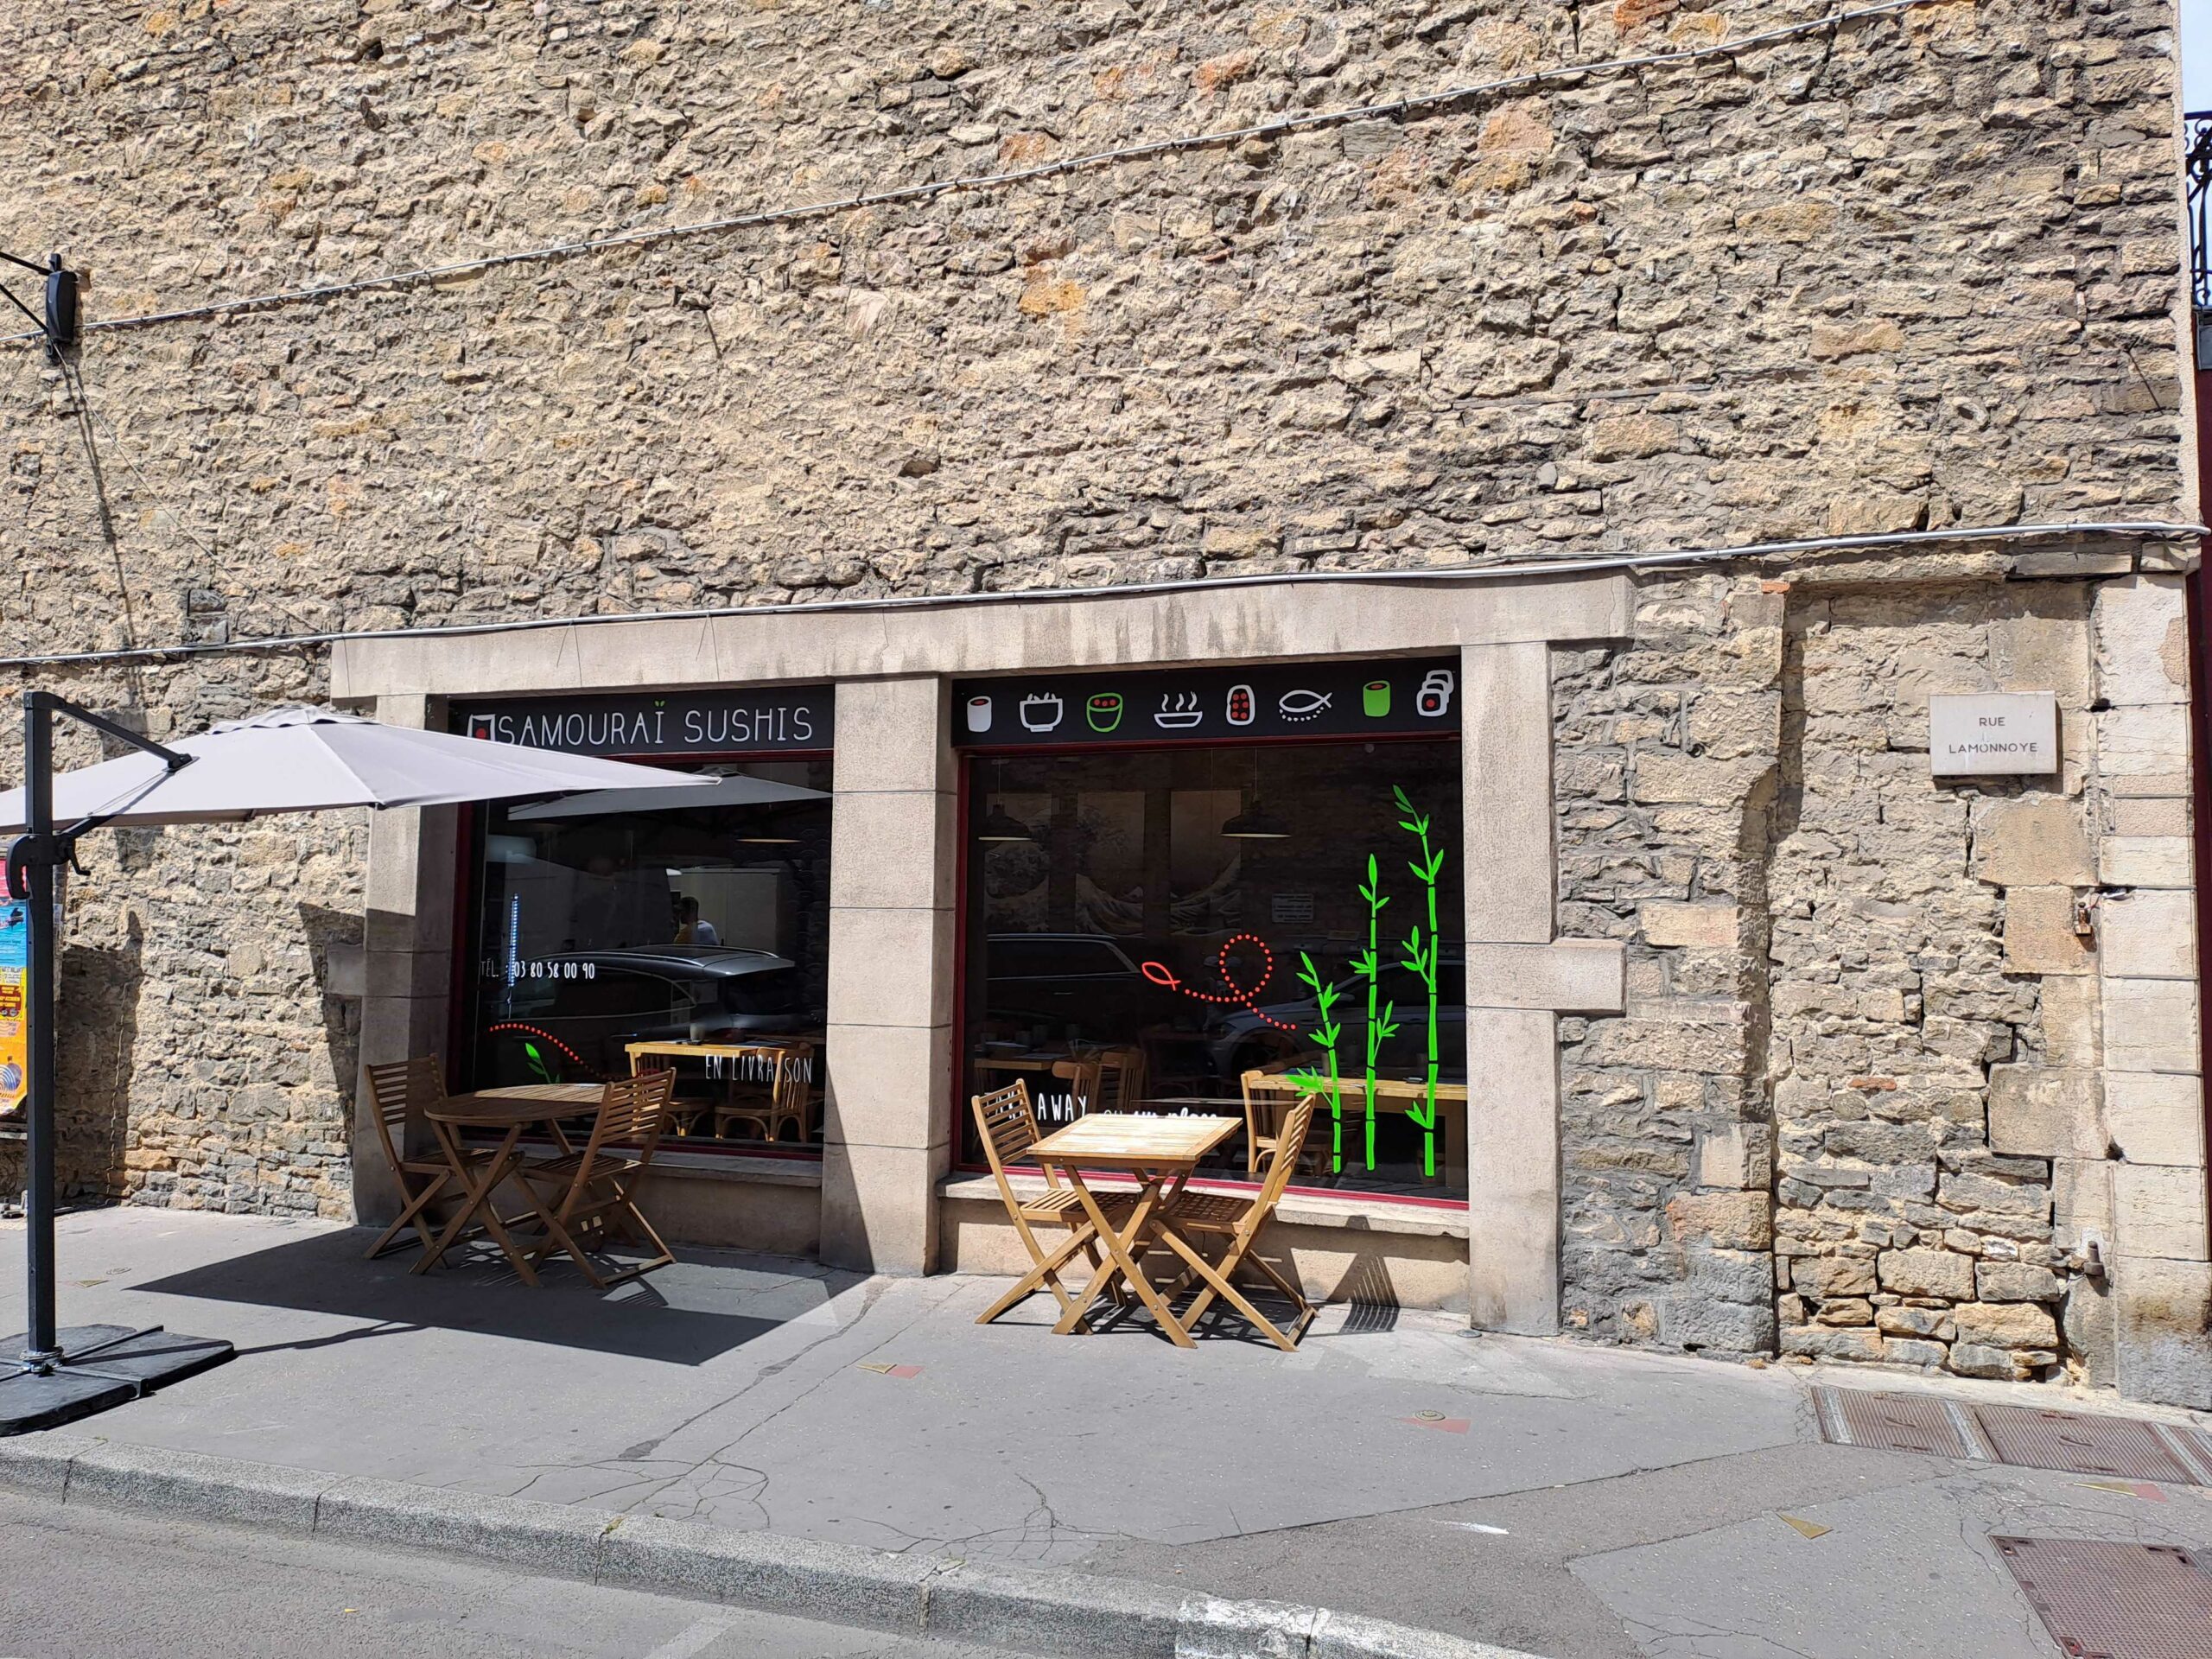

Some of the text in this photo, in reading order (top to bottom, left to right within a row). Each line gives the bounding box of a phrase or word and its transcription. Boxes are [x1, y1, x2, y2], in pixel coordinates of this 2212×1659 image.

[498, 701, 812, 746] SAMOURAÏ SUSHIS
[1979, 717, 2005, 727] RUE
[1948, 742, 2037, 753] LAMONNOYE
[514, 960, 526, 978] 03
[530, 962, 543, 978] 80
[547, 961, 560, 979] 58
[564, 962, 577, 979] 00
[582, 962, 595, 980] 90
[705, 1053, 722, 1080] EN
[1038, 1092, 1087, 1122] AWAY
